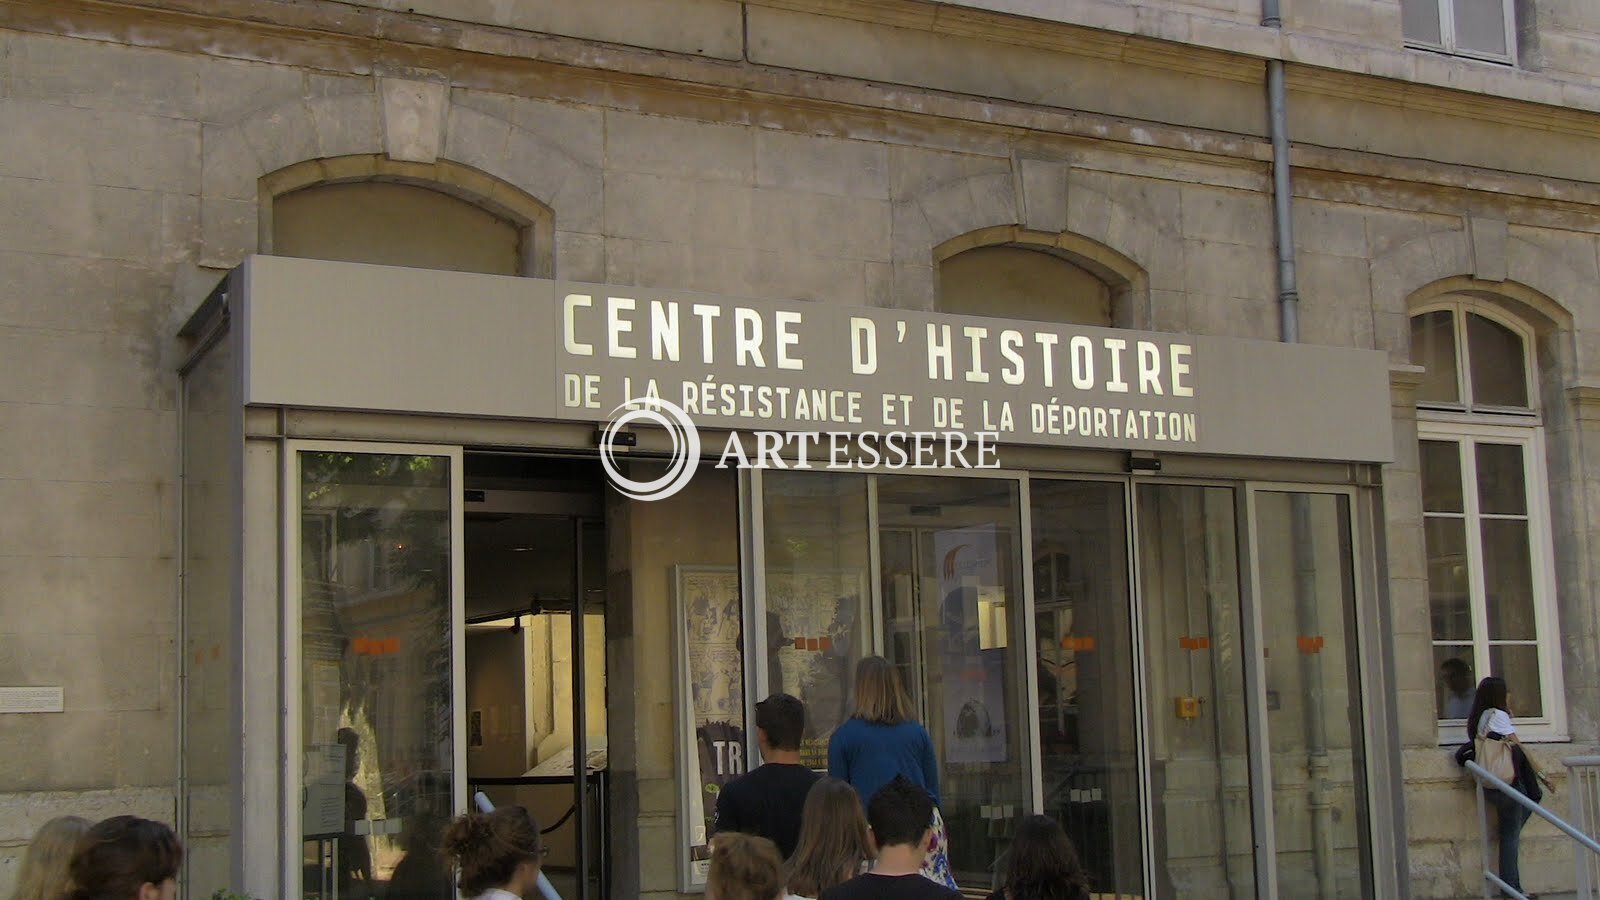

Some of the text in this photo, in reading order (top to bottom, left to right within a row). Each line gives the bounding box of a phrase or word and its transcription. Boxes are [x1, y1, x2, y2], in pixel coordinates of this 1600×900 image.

[563, 293, 1194, 398] CENTRE D'HISTOIRE
[564, 373, 1197, 442] DE LA RÉSISTANCE ET DE LA DÉPORTATION
